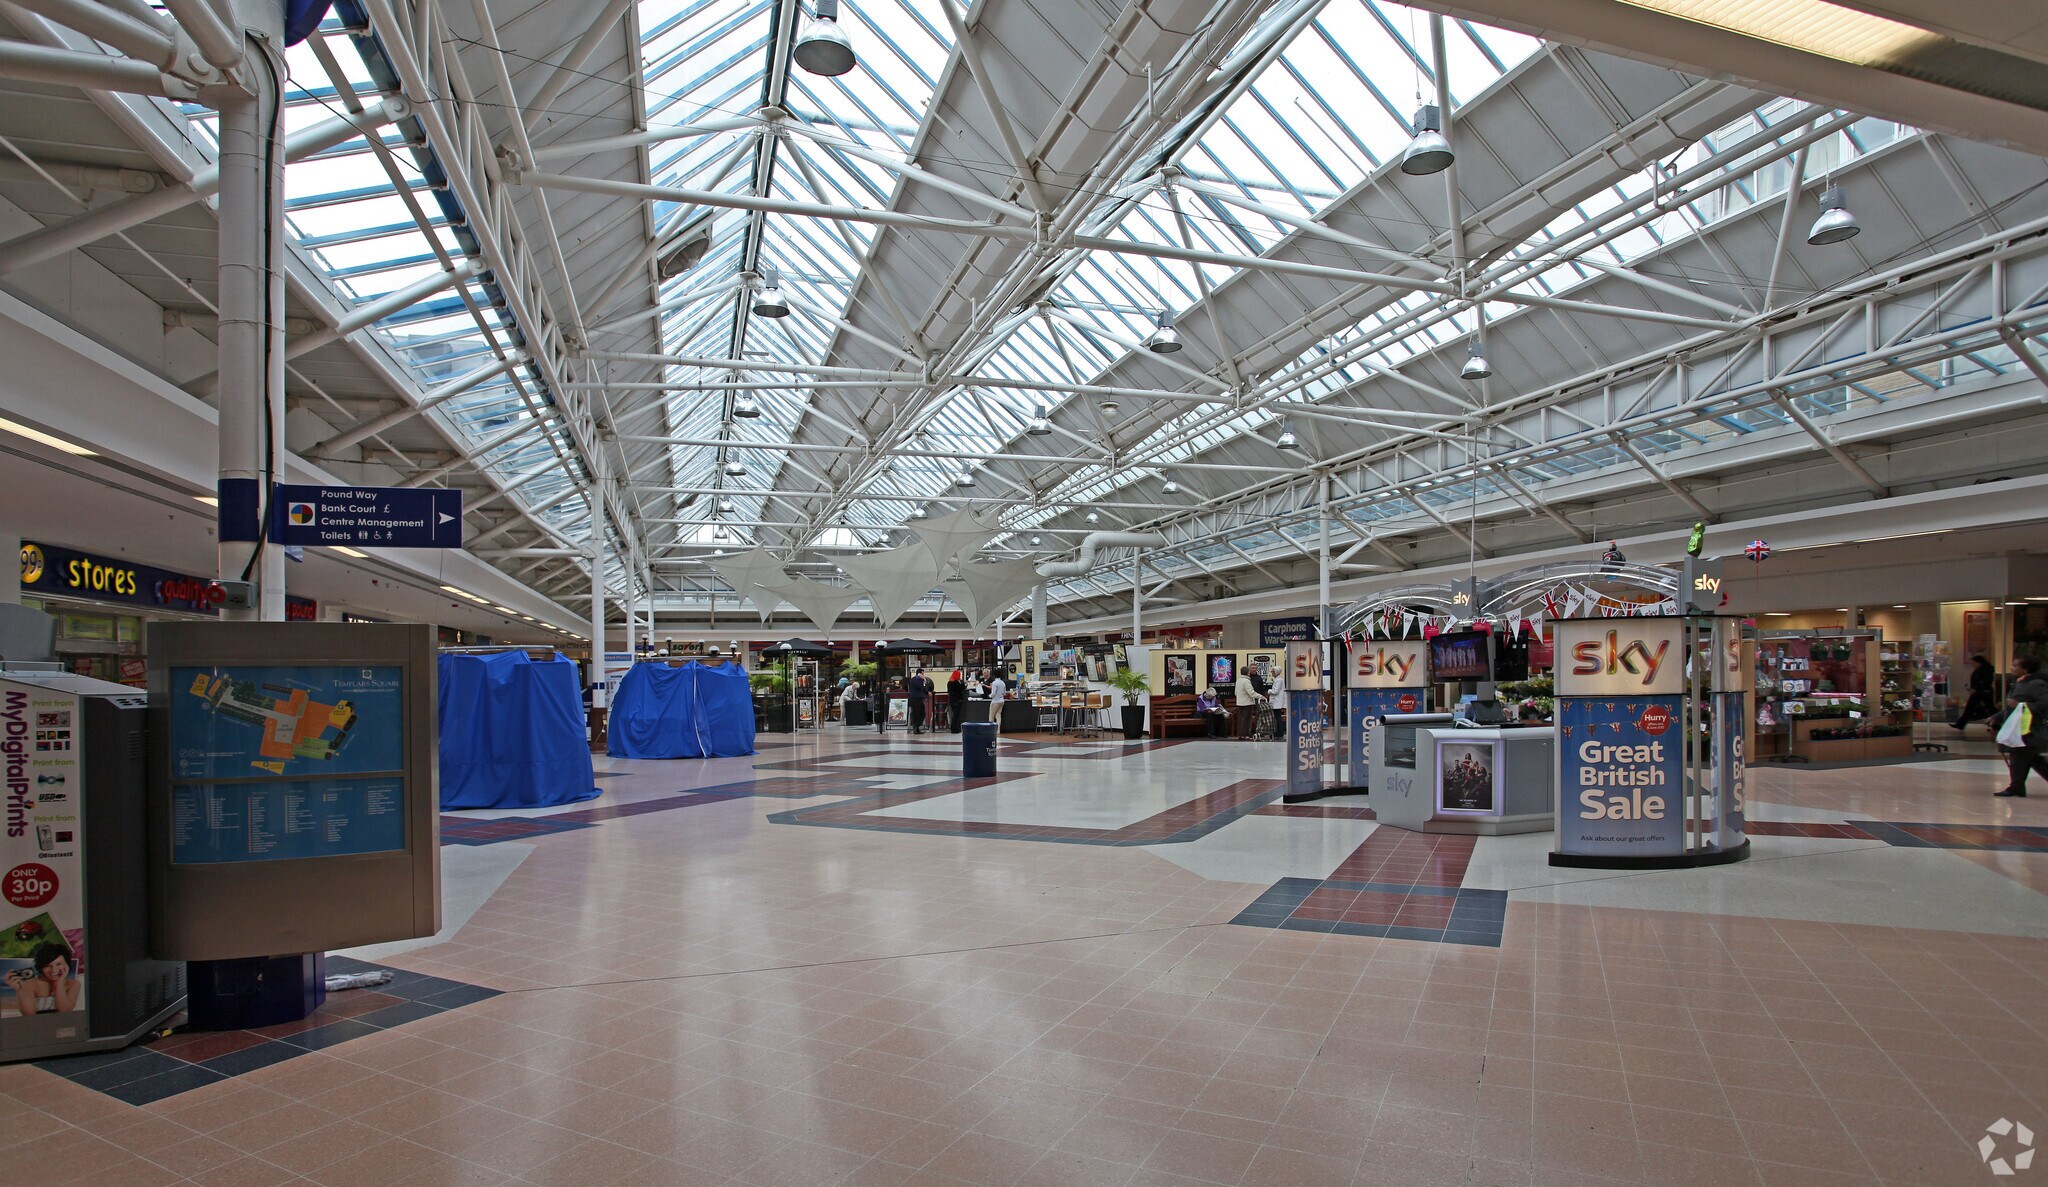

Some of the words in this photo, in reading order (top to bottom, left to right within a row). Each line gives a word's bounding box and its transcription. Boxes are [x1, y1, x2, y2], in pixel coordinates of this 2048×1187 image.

[321, 490, 353, 499] Pound
[355, 491, 377, 500] Way
[321, 504, 346, 513] Bank
[349, 505, 376, 513] Court
[383, 504, 390, 513] £
[321, 517, 355, 526] Centre
[357, 518, 424, 528] Management
[320, 531, 351, 540] Toilets
[69, 558, 137, 595] stores
[1694, 574, 1721, 594] sky
[1453, 591, 1471, 606] sky
[1268, 622, 1307, 634] Carphone
[1358, 647, 1416, 682] sky
[1571, 629, 1670, 685] sky
[1644, 714, 1667, 722] Hurry
[1579, 740, 1665, 764] Great
[0, 691, 31, 838] MyDigitalPrints
[1579, 765, 1665, 786] British
[1386, 772, 1412, 798] sky
[1579, 788, 1665, 820] Sale
[12, 868, 38, 877] ONLY
[12, 878, 52, 895] 30p
